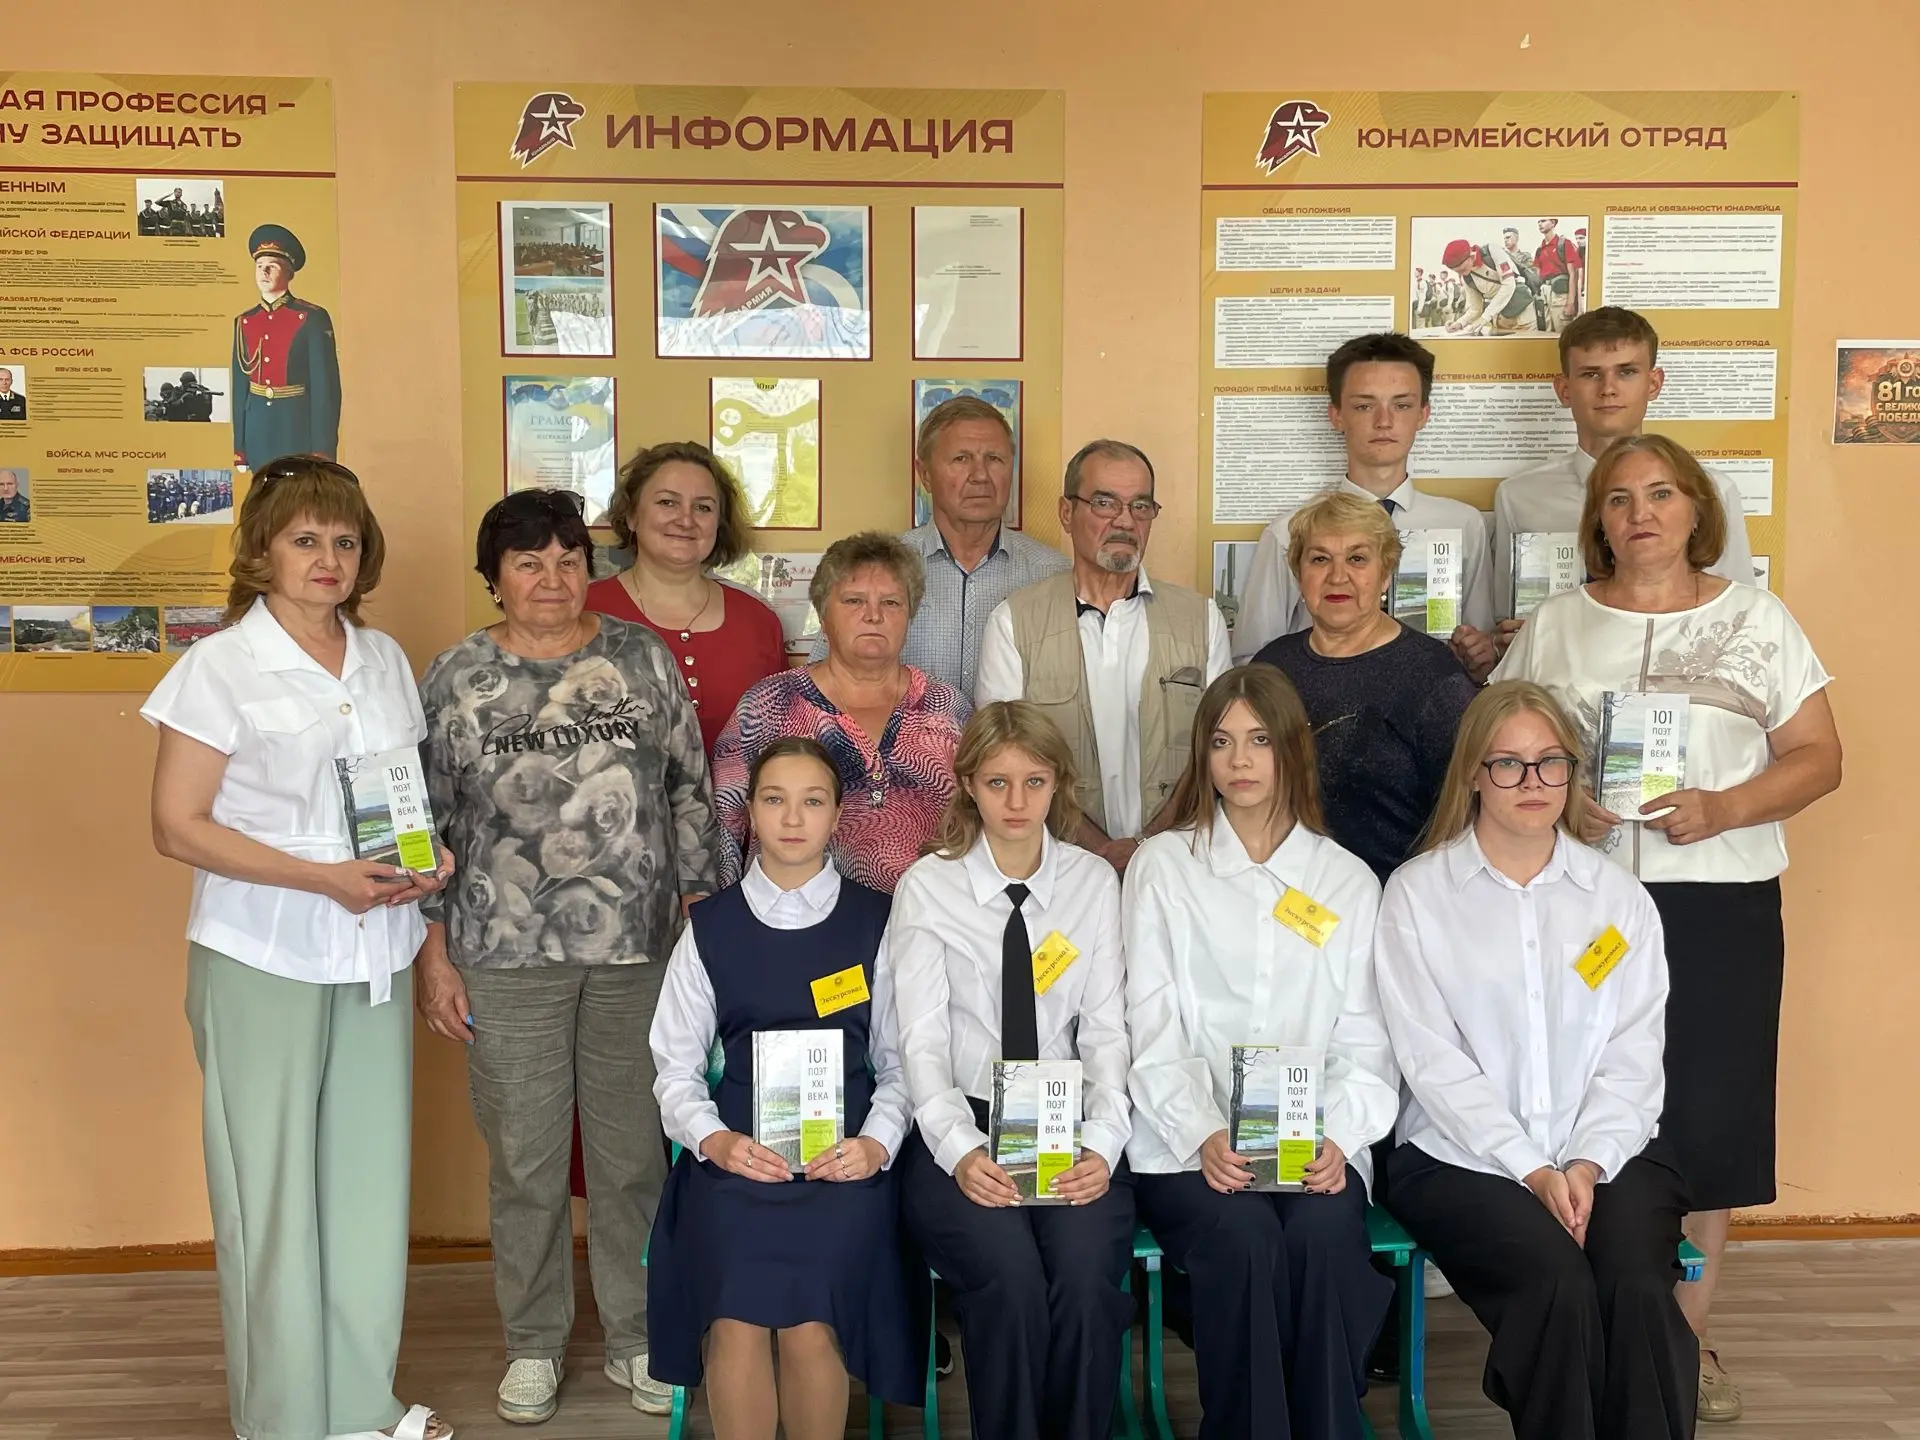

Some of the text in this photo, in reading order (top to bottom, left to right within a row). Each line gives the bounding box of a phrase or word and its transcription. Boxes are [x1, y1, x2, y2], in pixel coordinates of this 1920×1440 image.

[0, 89, 44, 110] АЯ
[56, 91, 267, 115] ПРОФЕССИЯ
[41, 123, 242, 150] ЗАЩИЩАТЬ
[606, 114, 1014, 159] ИНФОРМАЦИЯ
[1357, 121, 1728, 151] ЮНАРМЕЙСКИЙ ОТРЯД
[0, 181, 66, 193] ЕННЫМ
[1262, 207, 1294, 215] ОБЩИЕ
[1725, 204, 1781, 212] ЮНАРМЕЙЦА
[50, 230, 131, 240] ФЕДЕРАЦИИ
[736, 286, 774, 313] АРМИЯ
[1661, 339, 1733, 347] ЮНАРМЕЙСКОГО
[10, 347, 38, 356] ФСБ
[42, 348, 95, 357] РОССИИ
[1877, 381, 1902, 401] 81
[1884, 402, 1920, 411] ВЕЛИК
[530, 413, 592, 427] ГРАМО
[1879, 412, 1920, 424] ПОБЕД
[46, 449, 167, 459] ВОЙСКА МЧС РОССИИ
[1721, 449, 1762, 457] ОТРЯДОВ
[1433, 543, 1450, 555] 101
[1556, 547, 1574, 560] 101
[55, 556, 86, 564] ИГРЫ
[1556, 562, 1573, 570] ПОЭТ
[1555, 581, 1574, 590] ВЕКА
[1653, 710, 1672, 725] 101
[1652, 728, 1672, 736] ПОЭТ
[495, 731, 545, 756] NEW
[554, 719, 641, 749] LUXURY
[1650, 749, 1671, 758] ВЕКА
[388, 765, 409, 782] 101
[393, 782, 412, 793] ПОЭТ
[397, 805, 418, 816] ВЕКА
[807, 1048, 827, 1063] 101
[808, 1067, 828, 1076] ПОЭТ
[1287, 1067, 1308, 1083] 101
[1046, 1081, 1066, 1097] 101
[1287, 1086, 1308, 1096] ПОЭТ
[807, 1092, 829, 1101] ВЕКА
[1046, 1100, 1066, 1109] ПОЭТ
[1286, 1111, 1308, 1121] ВЕКА
[1045, 1125, 1067, 1134] ВЕКА
